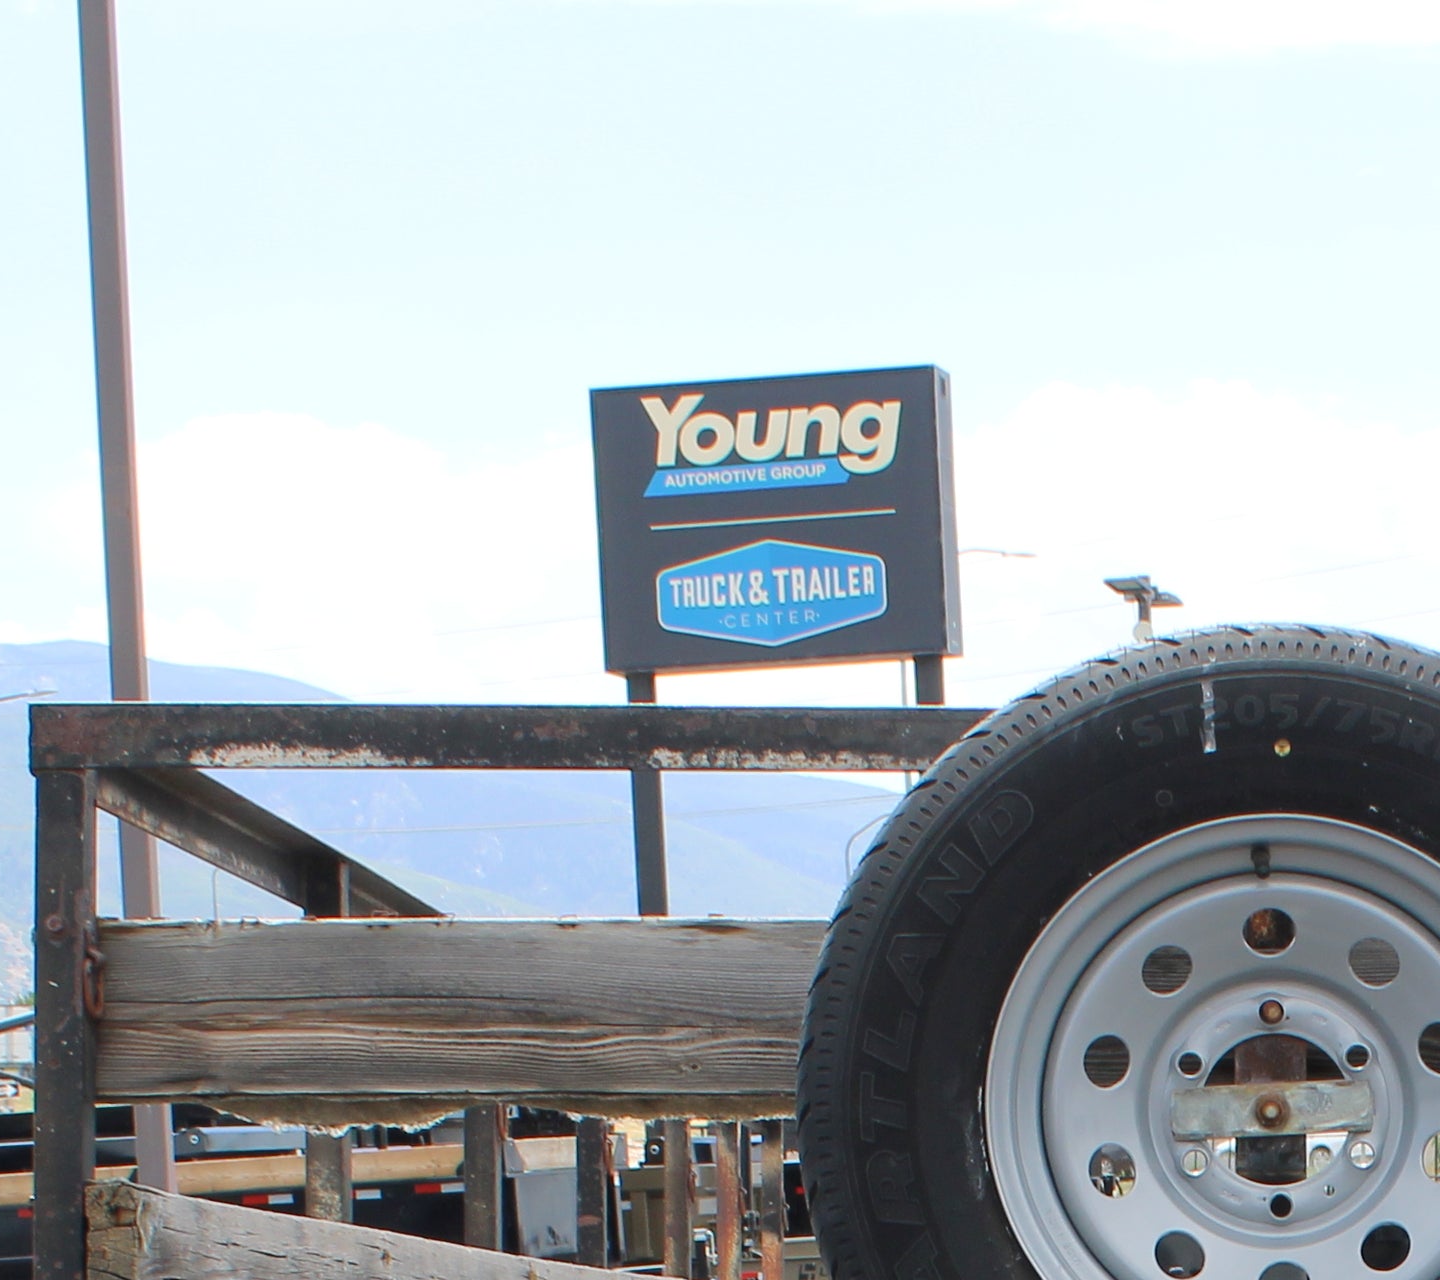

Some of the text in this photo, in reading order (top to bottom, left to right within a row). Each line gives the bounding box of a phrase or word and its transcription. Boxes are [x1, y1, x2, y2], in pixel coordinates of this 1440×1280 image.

[640, 393, 902, 475] Young
[664, 463, 827, 488] AUTOMOTIVE GROUP
[669, 564, 876, 608] TRUCK & TRAILER
[724, 609, 817, 629] CENTER
